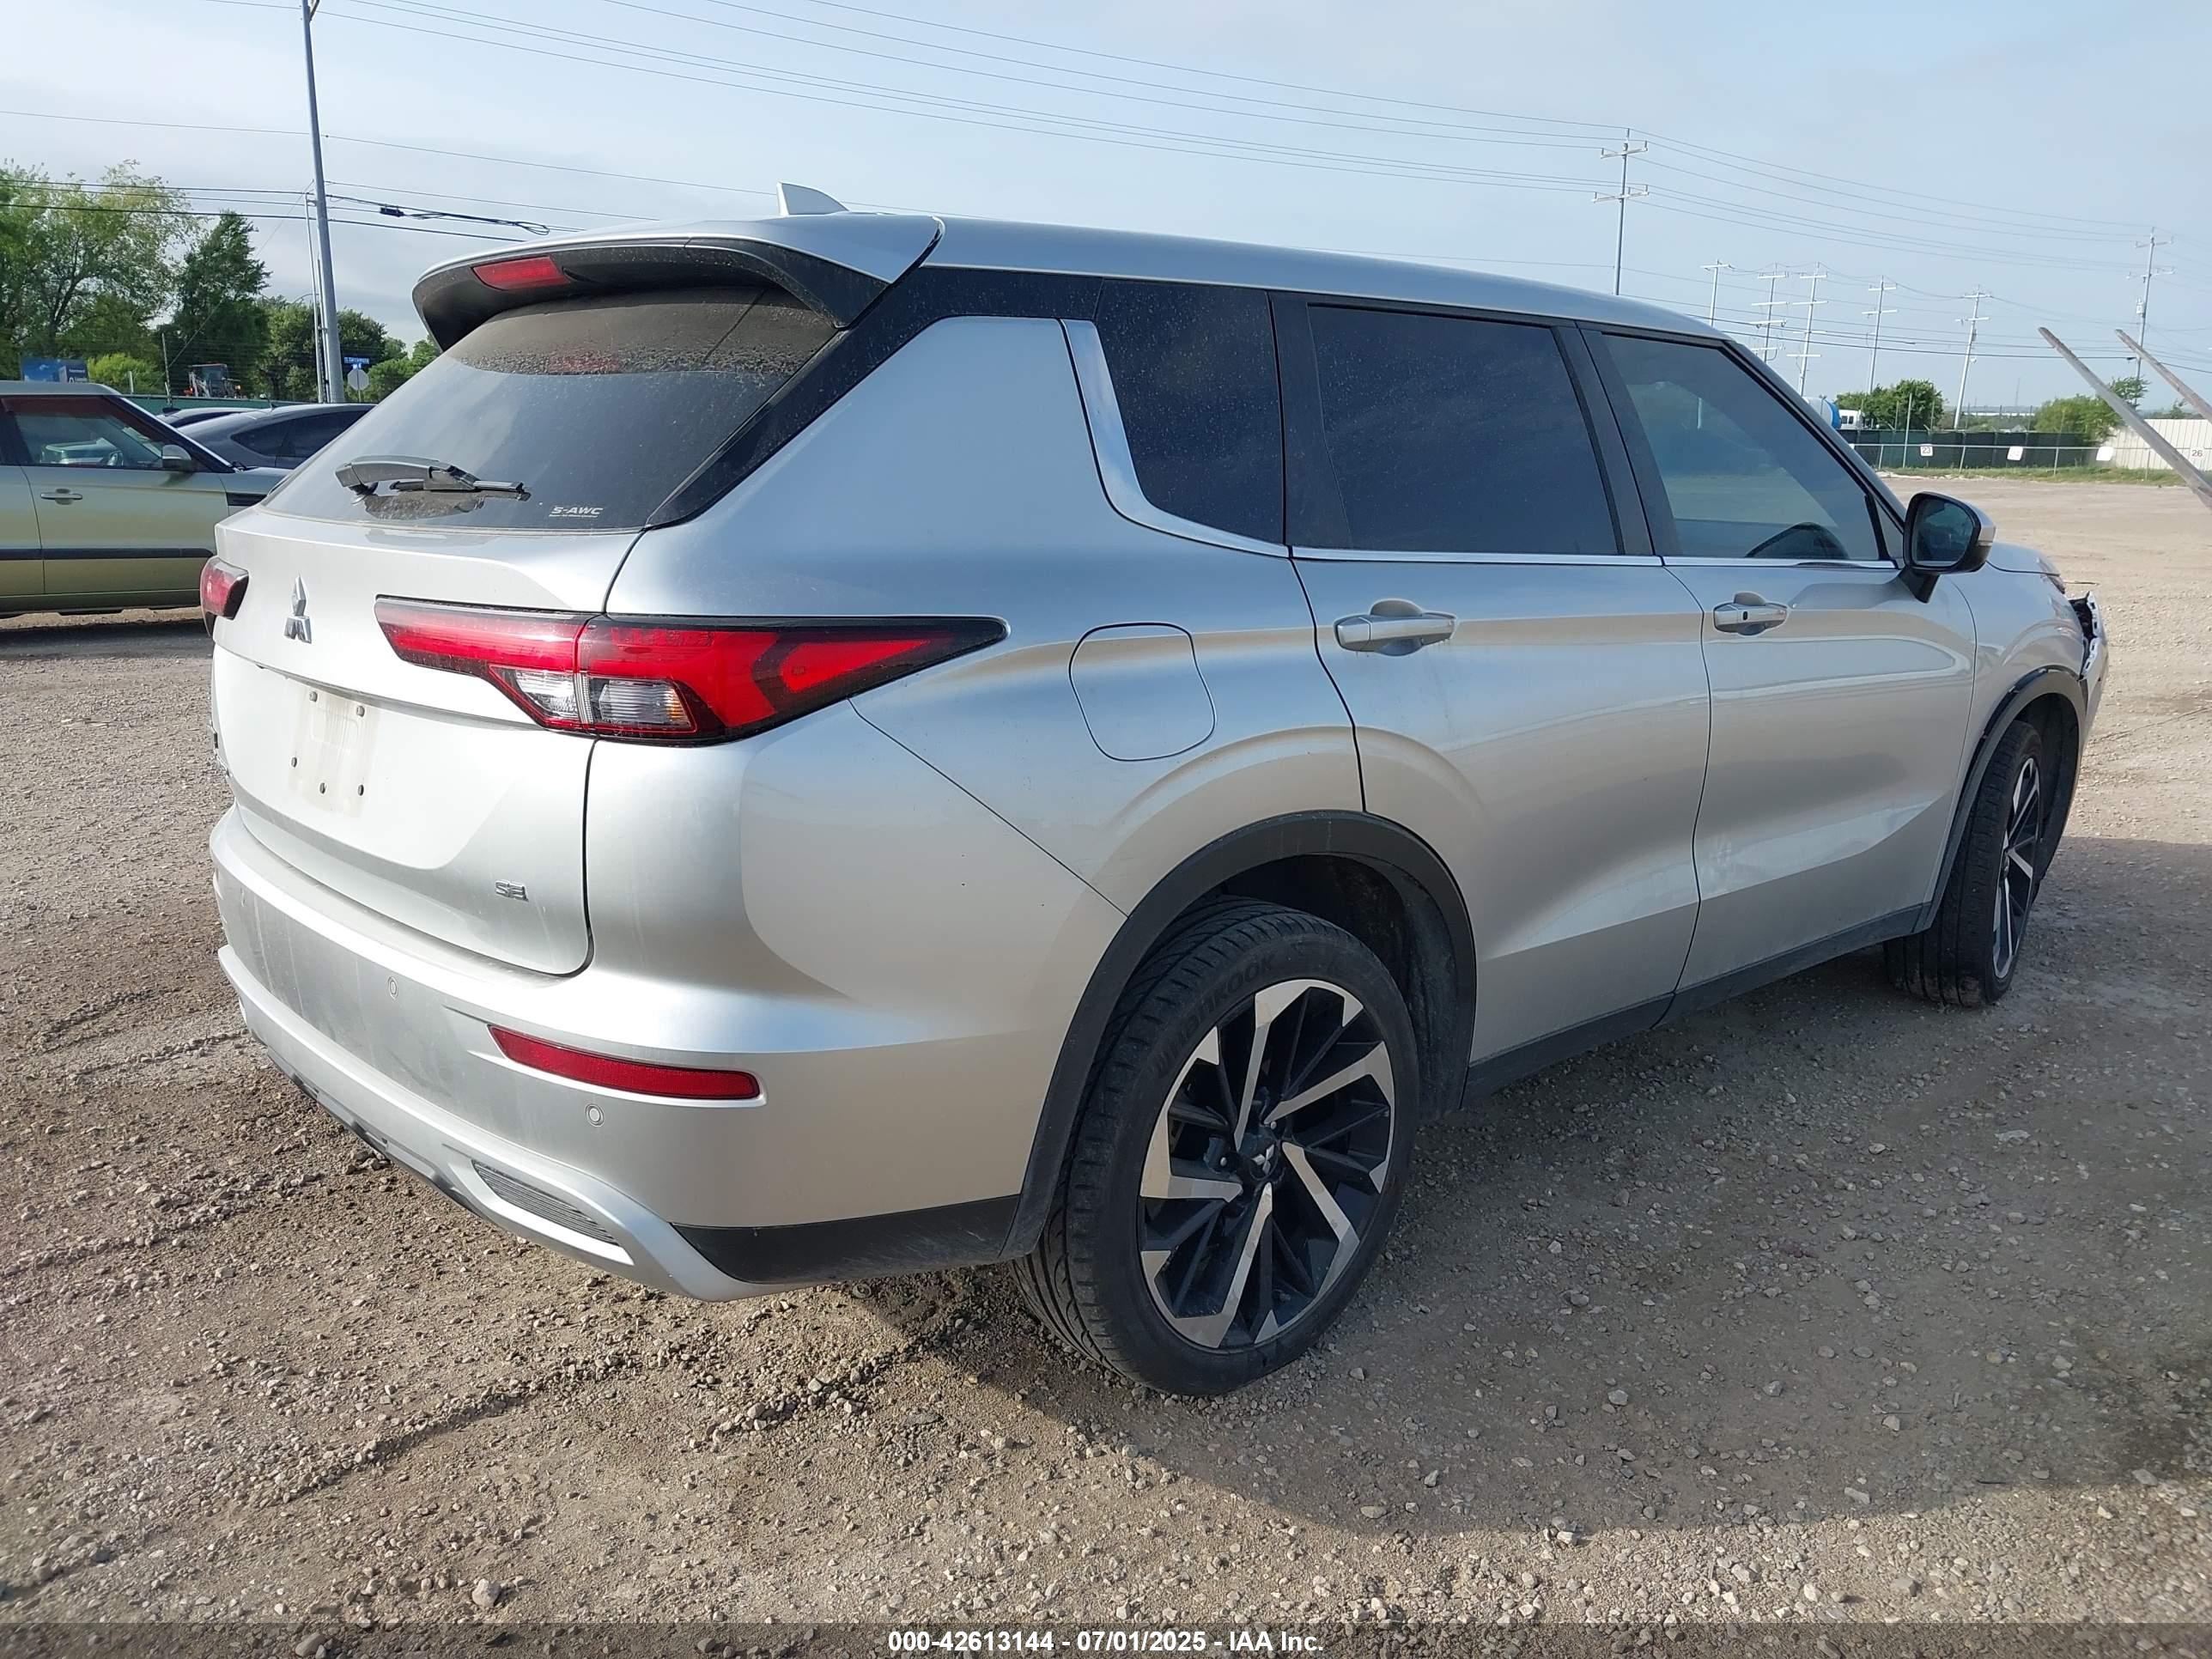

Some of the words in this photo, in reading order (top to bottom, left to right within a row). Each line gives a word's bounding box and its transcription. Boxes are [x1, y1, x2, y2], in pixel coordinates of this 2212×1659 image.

[2191, 449, 2203, 458] 26
[550, 506, 604, 515] S-AWC
[495, 880, 527, 901] SE
